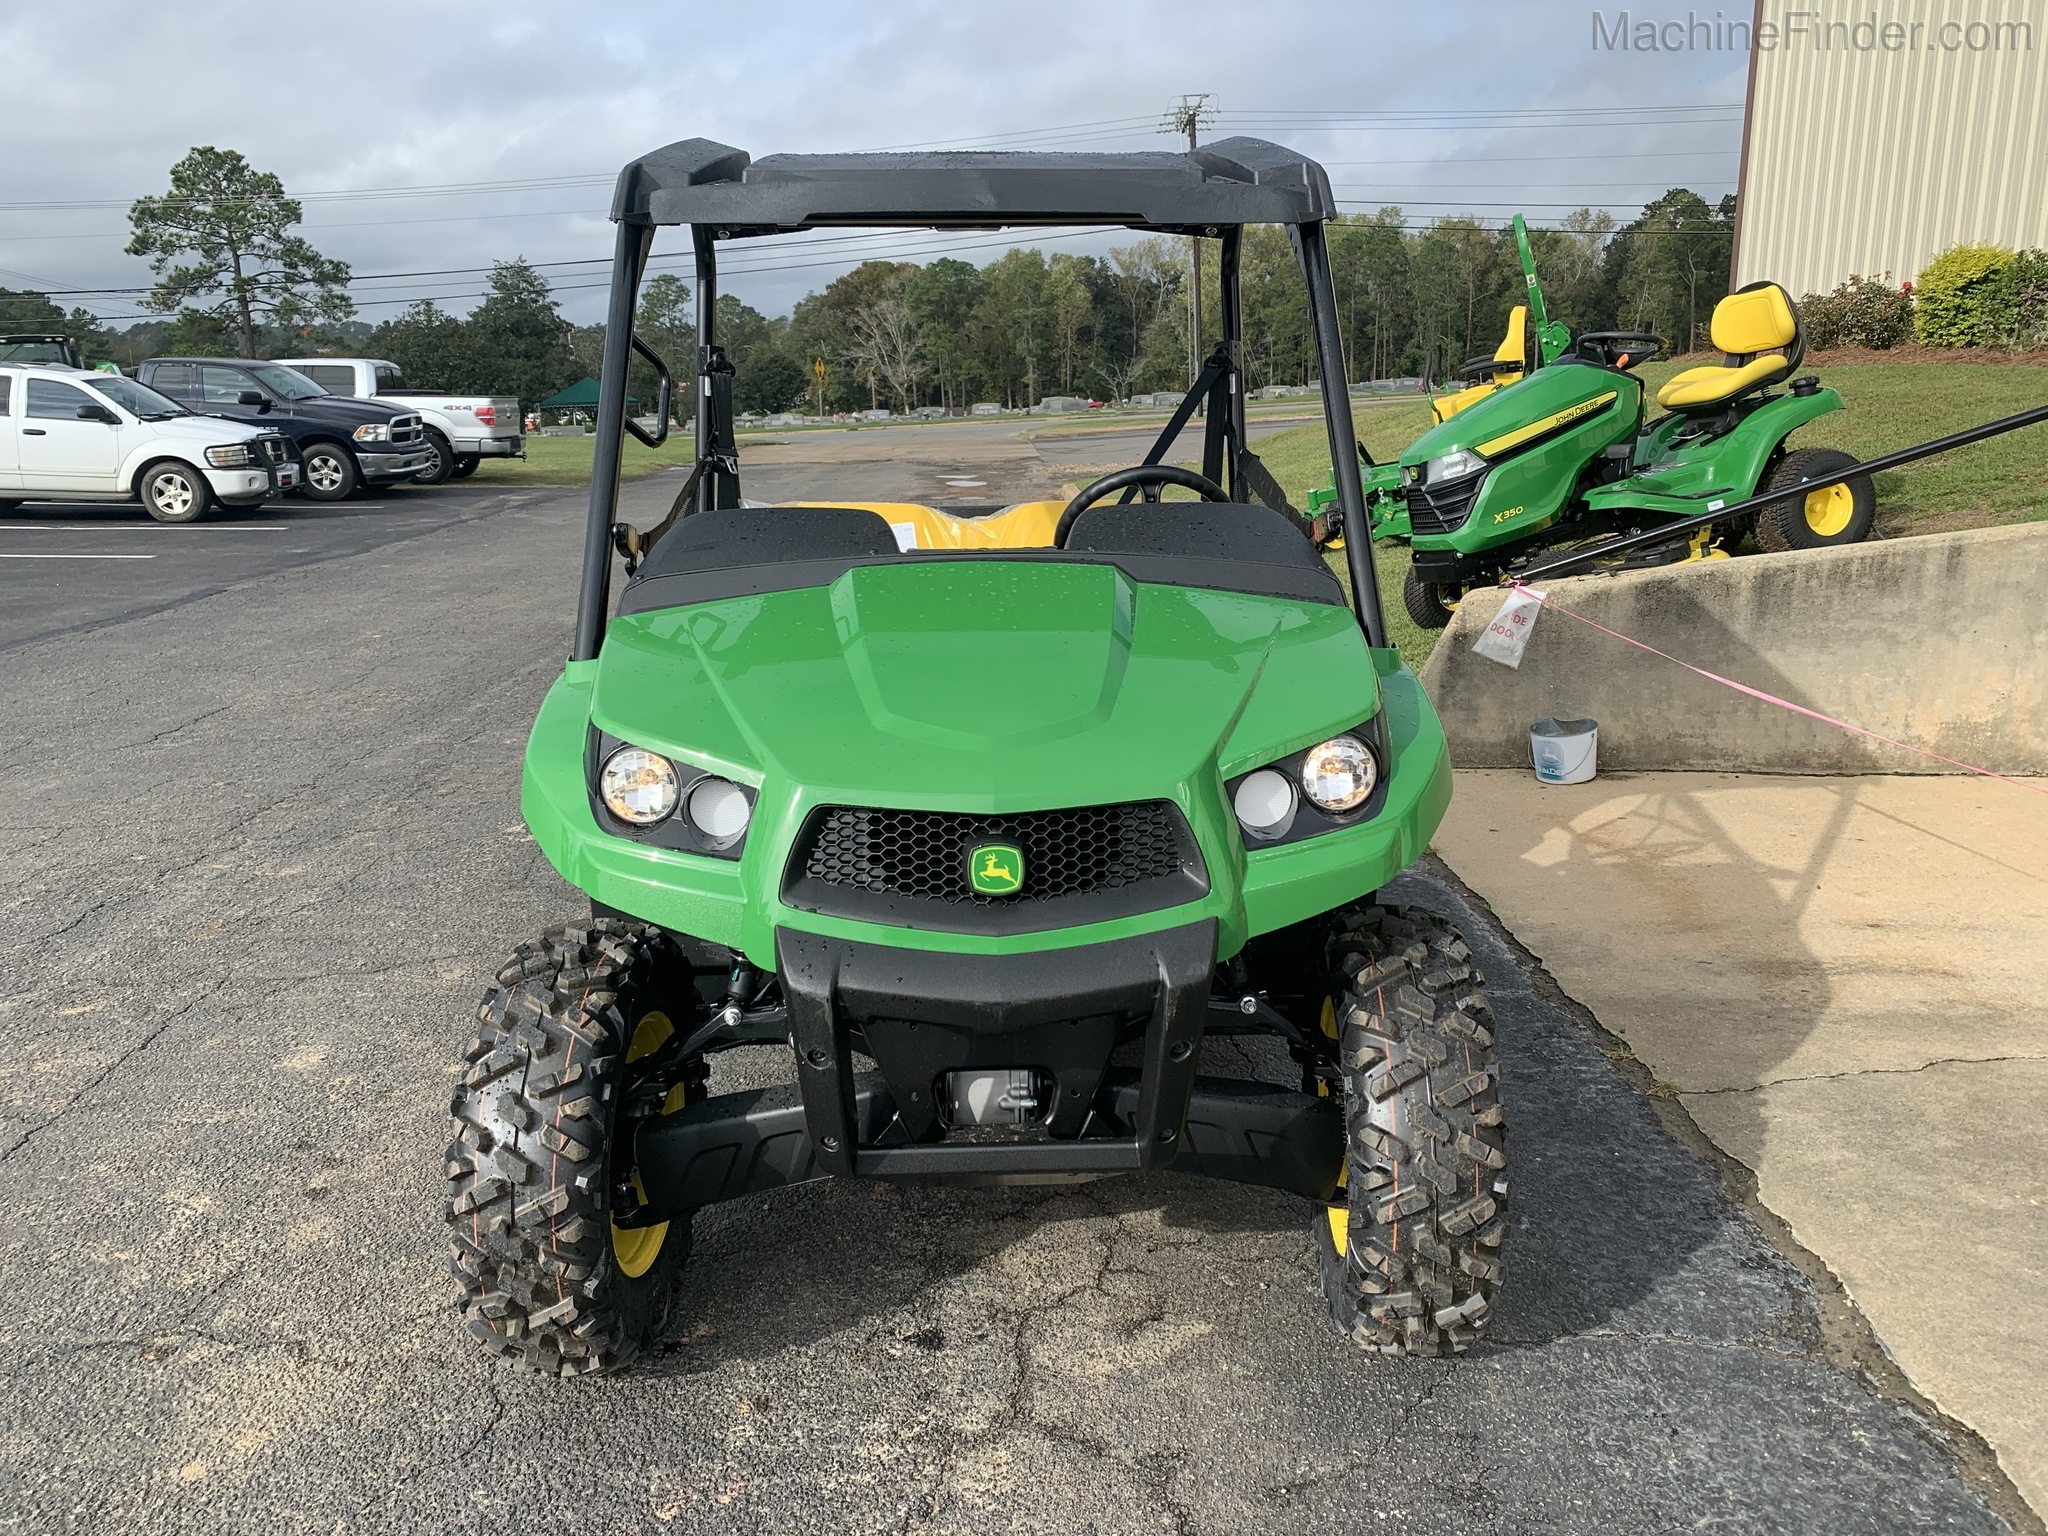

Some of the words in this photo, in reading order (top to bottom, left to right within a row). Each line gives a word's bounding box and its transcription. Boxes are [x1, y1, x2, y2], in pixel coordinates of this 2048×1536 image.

[1554, 410, 1575, 426] JOHN
[1574, 399, 1599, 416] DEERE
[1493, 506, 1524, 525] X350
